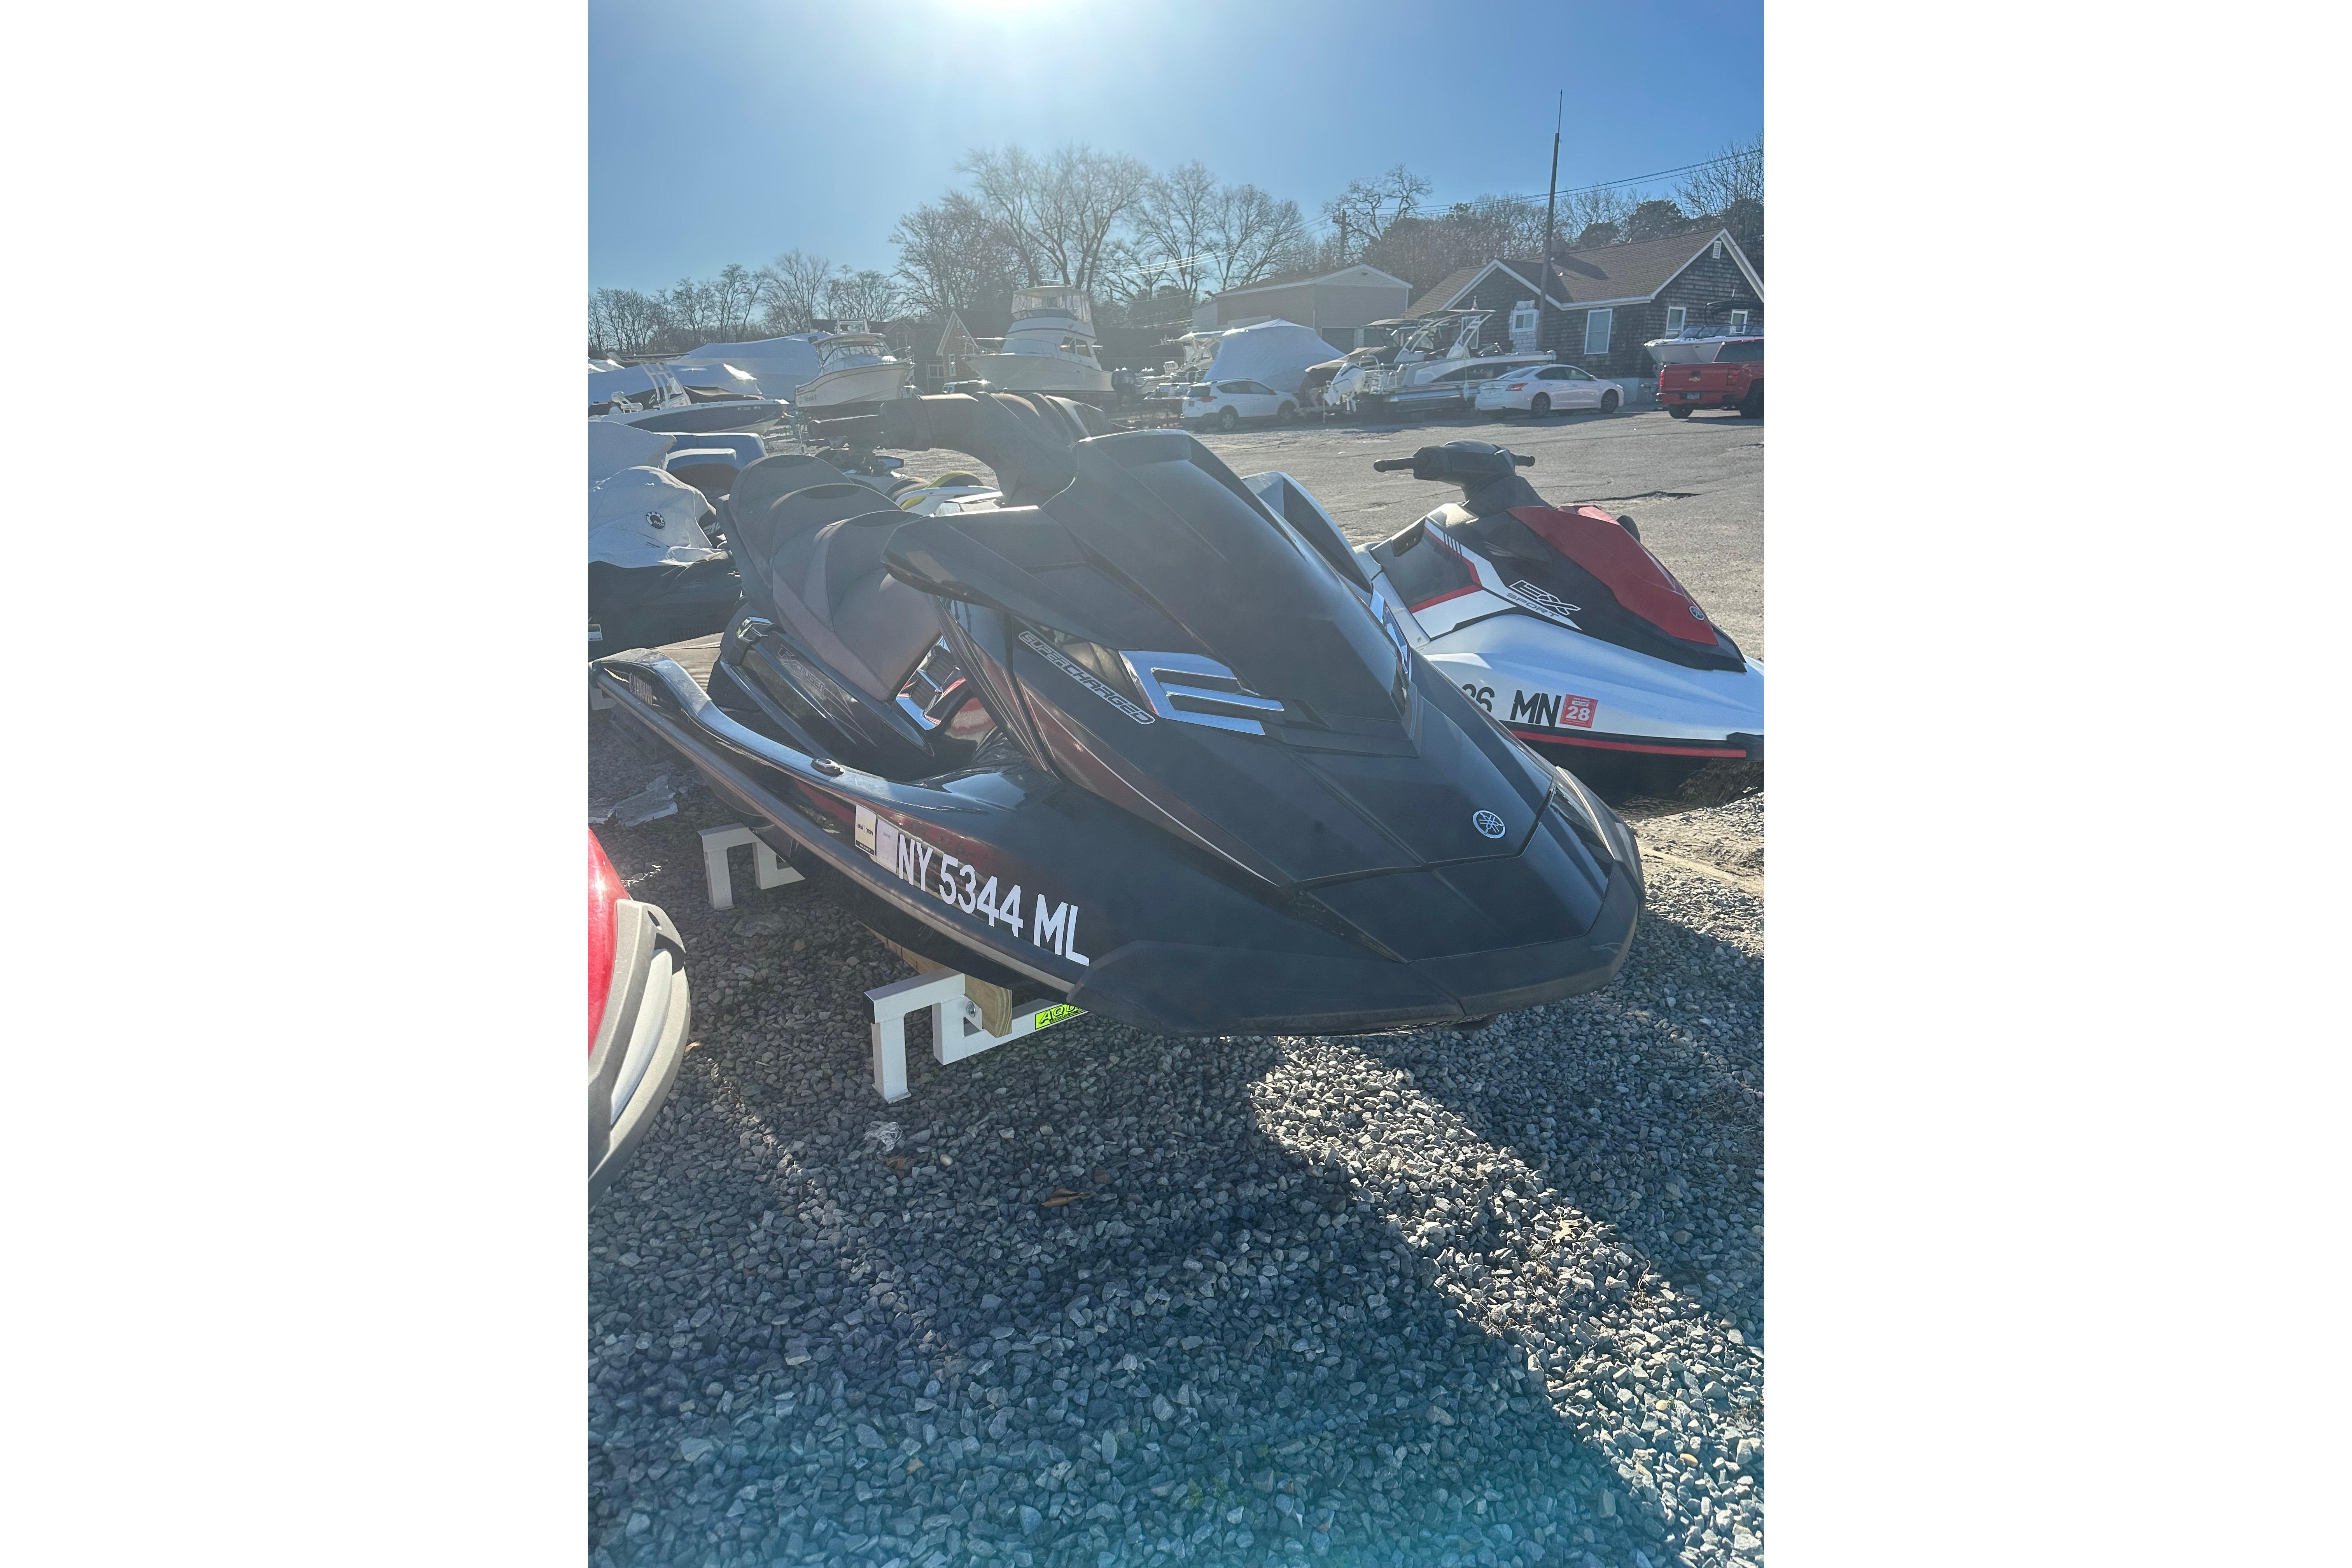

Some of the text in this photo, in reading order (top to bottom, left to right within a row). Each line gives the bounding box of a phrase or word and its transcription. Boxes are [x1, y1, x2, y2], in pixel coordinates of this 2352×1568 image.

[1506, 593, 1559, 618] SPORT
[1509, 579, 1582, 615] EX
[796, 664, 826, 694] CRUISER
[1020, 632, 1149, 721] SUPERCHARGED
[1510, 690, 1562, 727] MN
[1565, 706, 1591, 721] 28
[899, 834, 1089, 966] NY 5344 ML
[1040, 1005, 1078, 1024] AQU
